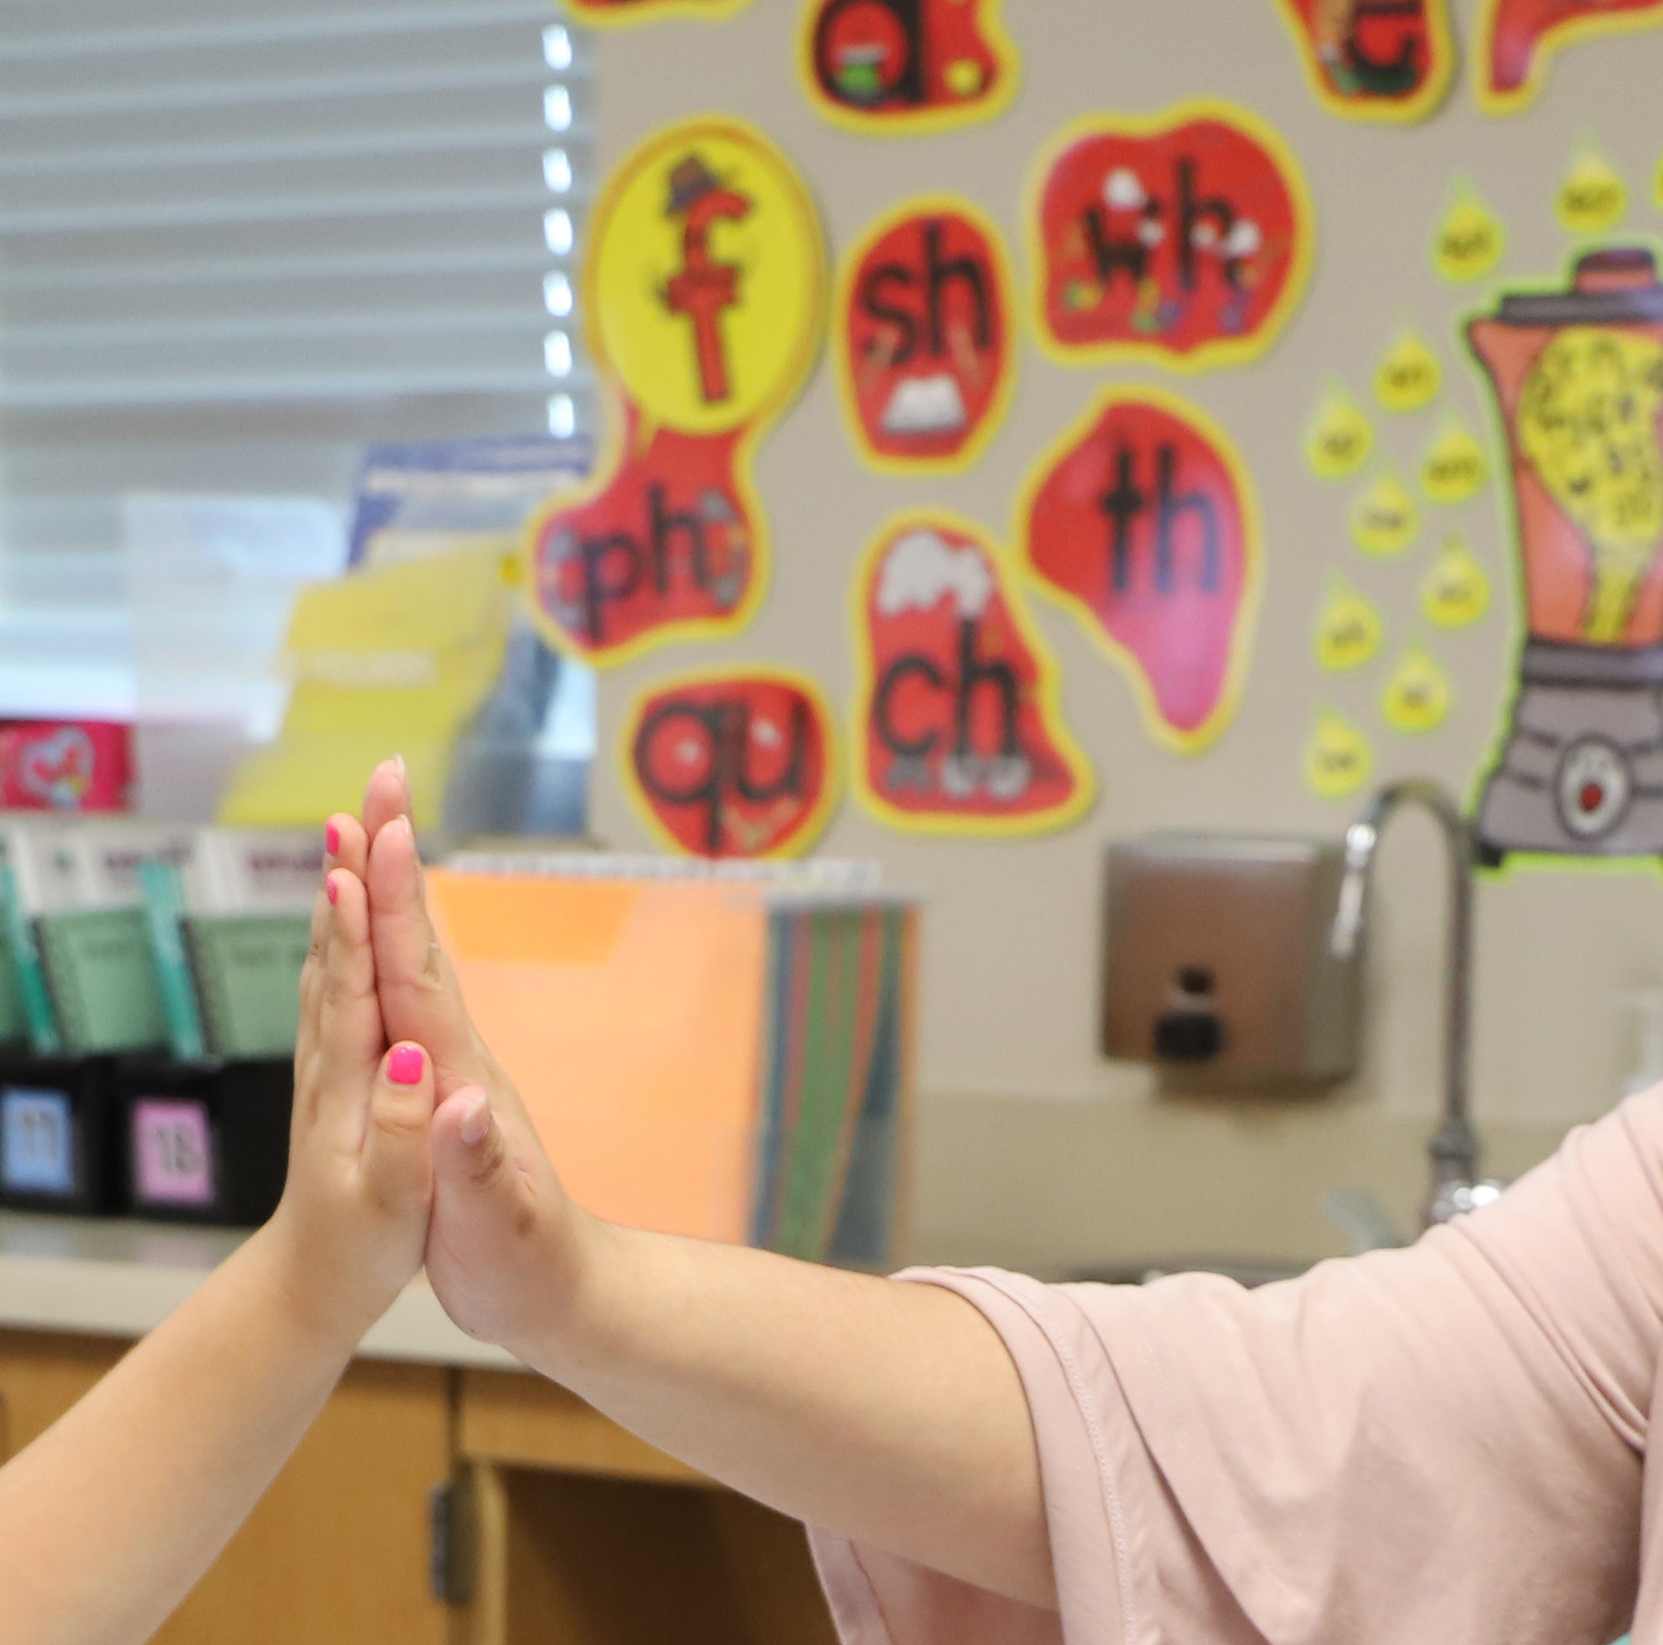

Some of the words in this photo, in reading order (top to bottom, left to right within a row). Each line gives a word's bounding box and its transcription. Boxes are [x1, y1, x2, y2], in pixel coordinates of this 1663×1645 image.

[665, 188, 753, 402] f
[860, 222, 993, 366] sh
[580, 480, 709, 642] ph
[1103, 445, 1221, 592] th
[875, 615, 1019, 758] ch
[633, 697, 809, 854] qu
